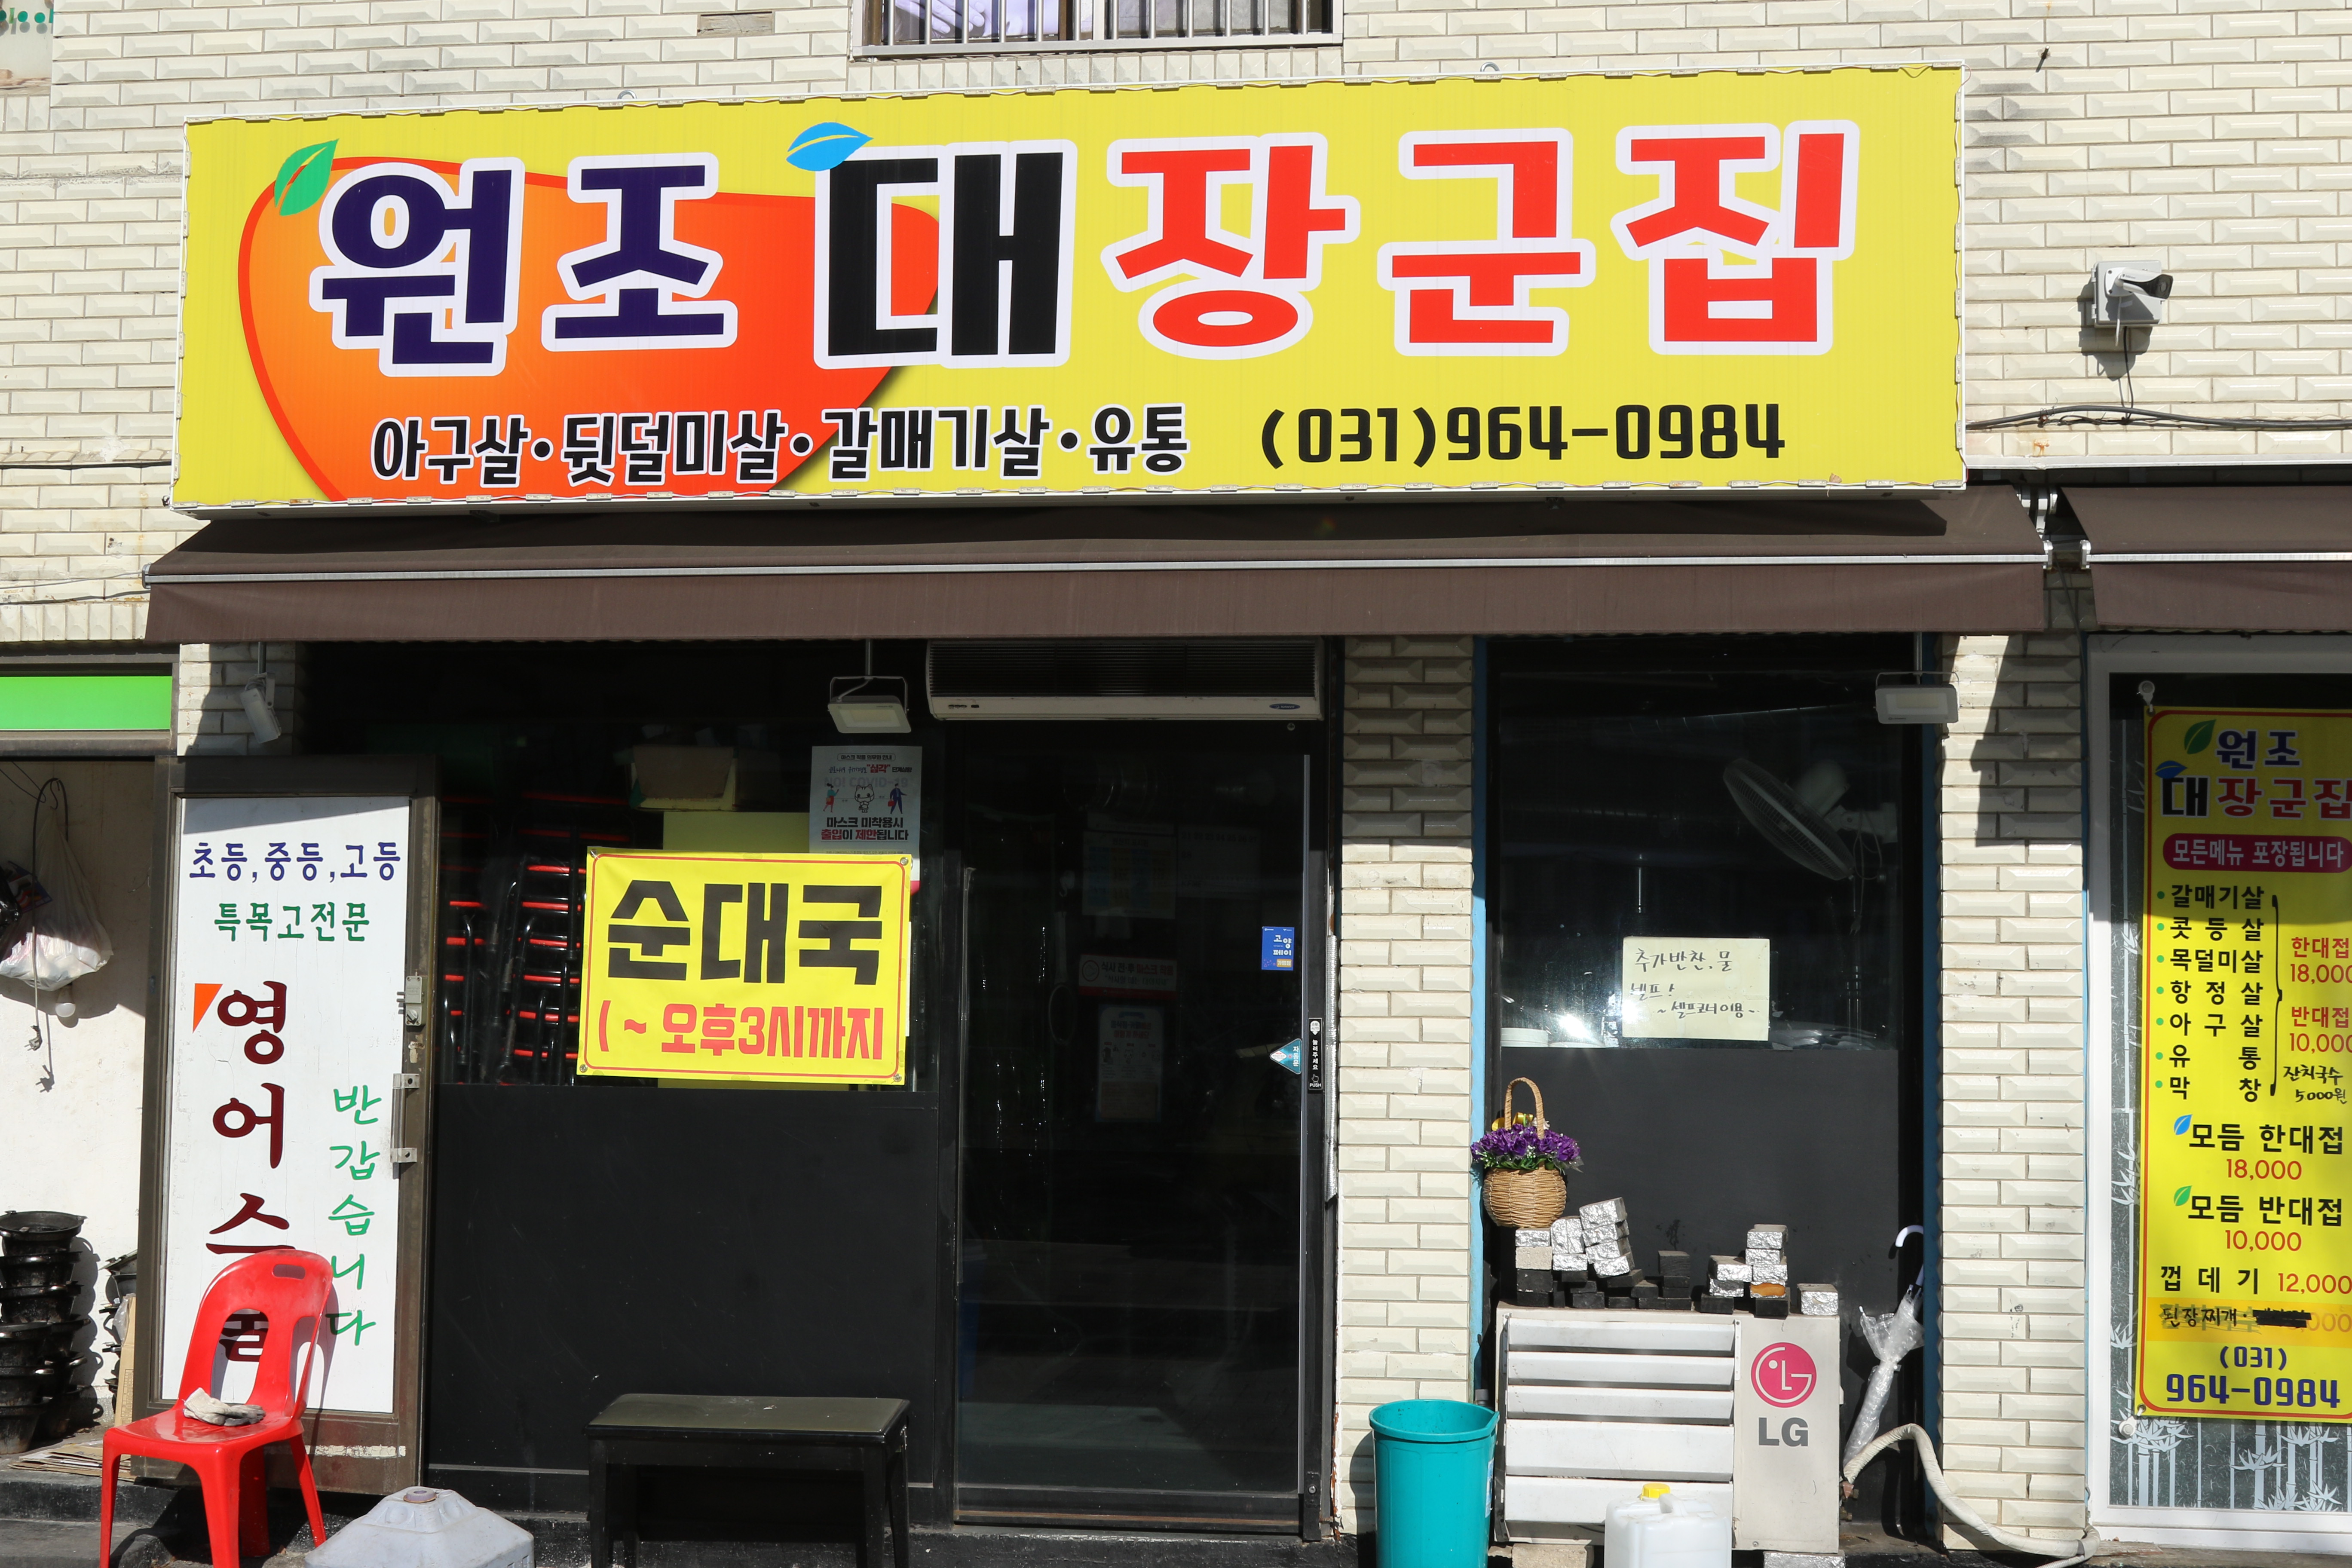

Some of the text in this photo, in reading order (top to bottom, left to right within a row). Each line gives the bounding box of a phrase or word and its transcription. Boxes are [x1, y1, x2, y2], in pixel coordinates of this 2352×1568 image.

[318, 130, 1848, 368] 원조 대장군집
[2216, 730, 2301, 770] 원조
[2162, 776, 2352, 819] 대장군집
[821, 829, 909, 841] 출입이 제한됩니다
[826, 817, 903, 828] 마스크 미착용시
[2173, 839, 2344, 868] 모든메뉴 포장됩니다
[2171, 884, 2265, 910] 갈매기살
[214, 901, 370, 942] 특목고전문
[607, 879, 883, 986] 순대국
[2169, 948, 2264, 974] 목덜미살
[2291, 937, 2350, 959] 한대접
[2291, 1006, 2349, 1028] 반대접
[661, 1002, 885, 1060] 오후3시까지
[2282, 1063, 2344, 1086] 잔치국수
[2188, 1123, 2343, 1155] 모듬 한대접
[2226, 1158, 2303, 1181] 18,000
[2187, 1194, 2343, 1227] 모듬 반대접
[2224, 1229, 2303, 1252] 10,000
[2277, 1272, 2352, 1295] 12,000
[2219, 1345, 2287, 1371] (031)
[2166, 1373, 2341, 1409] 964-0984
[1758, 1416, 1809, 1448] LG
